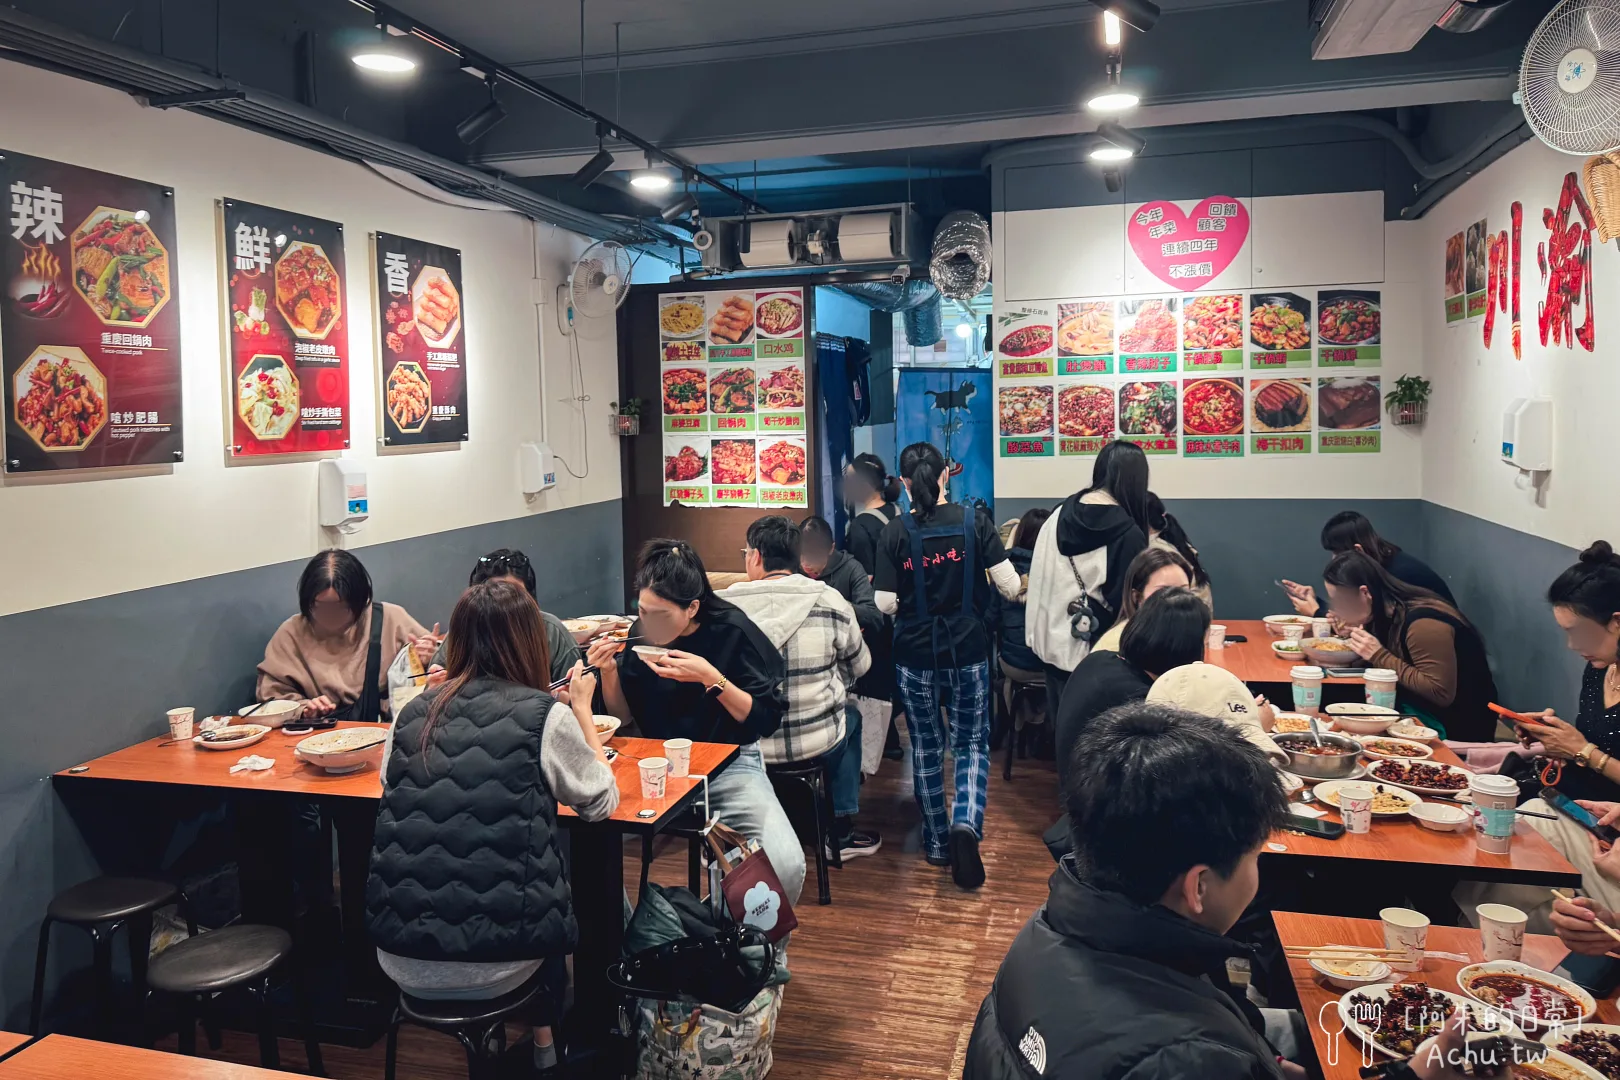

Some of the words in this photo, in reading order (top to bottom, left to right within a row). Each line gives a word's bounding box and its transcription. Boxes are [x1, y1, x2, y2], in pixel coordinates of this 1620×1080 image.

[10, 181, 66, 244] 辣
[1136, 208, 1163, 224] 今年
[1210, 203, 1237, 216] 回饋
[1149, 221, 1177, 238] 年菜
[1198, 219, 1226, 231] 顧客
[235, 221, 271, 273] 鮮
[1162, 239, 1218, 256] 連續四年
[384, 251, 409, 295] 香
[1170, 263, 1212, 277] 不漲價
[764, 343, 794, 354] 口水鸡
[1227, 702, 1248, 713] Lee
